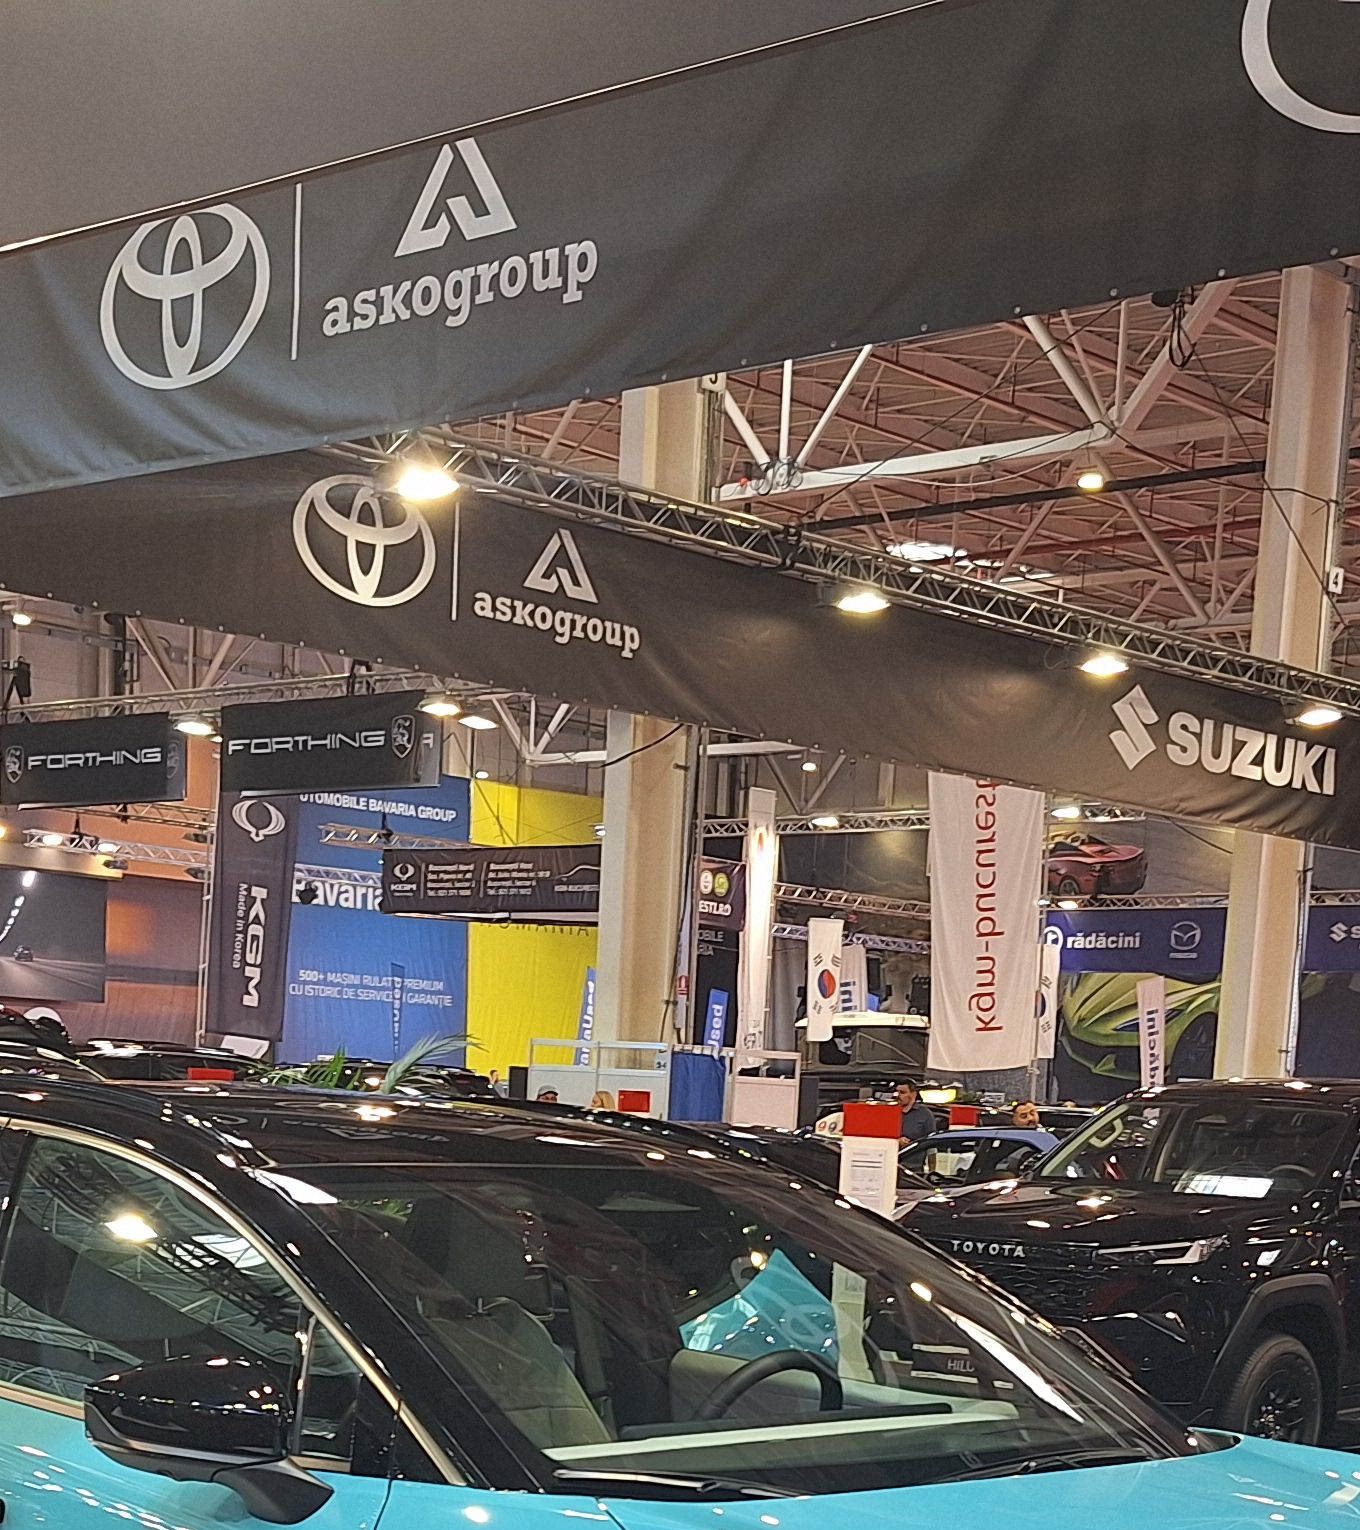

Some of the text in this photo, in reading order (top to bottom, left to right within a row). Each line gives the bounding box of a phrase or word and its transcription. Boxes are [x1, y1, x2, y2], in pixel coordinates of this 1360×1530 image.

[321, 236, 598, 337] askogroup
[473, 590, 641, 656] askogroup
[228, 730, 386, 756] FORTHING
[1166, 710, 1337, 797] SUZUKI
[27, 747, 162, 771] FORTHING
[300, 793, 457, 822] UTOMOBILE BAVARIA GROUP
[235, 883, 248, 917] Made
[232, 933, 245, 969] Korea
[242, 885, 268, 1008] KGM
[1066, 931, 1141, 949] rădăcini
[299, 969, 324, 982] 500+
[363, 974, 392, 987] RULAT
[343, 987, 356, 999] DE
[951, 1239, 1026, 1258] TOYOTA
